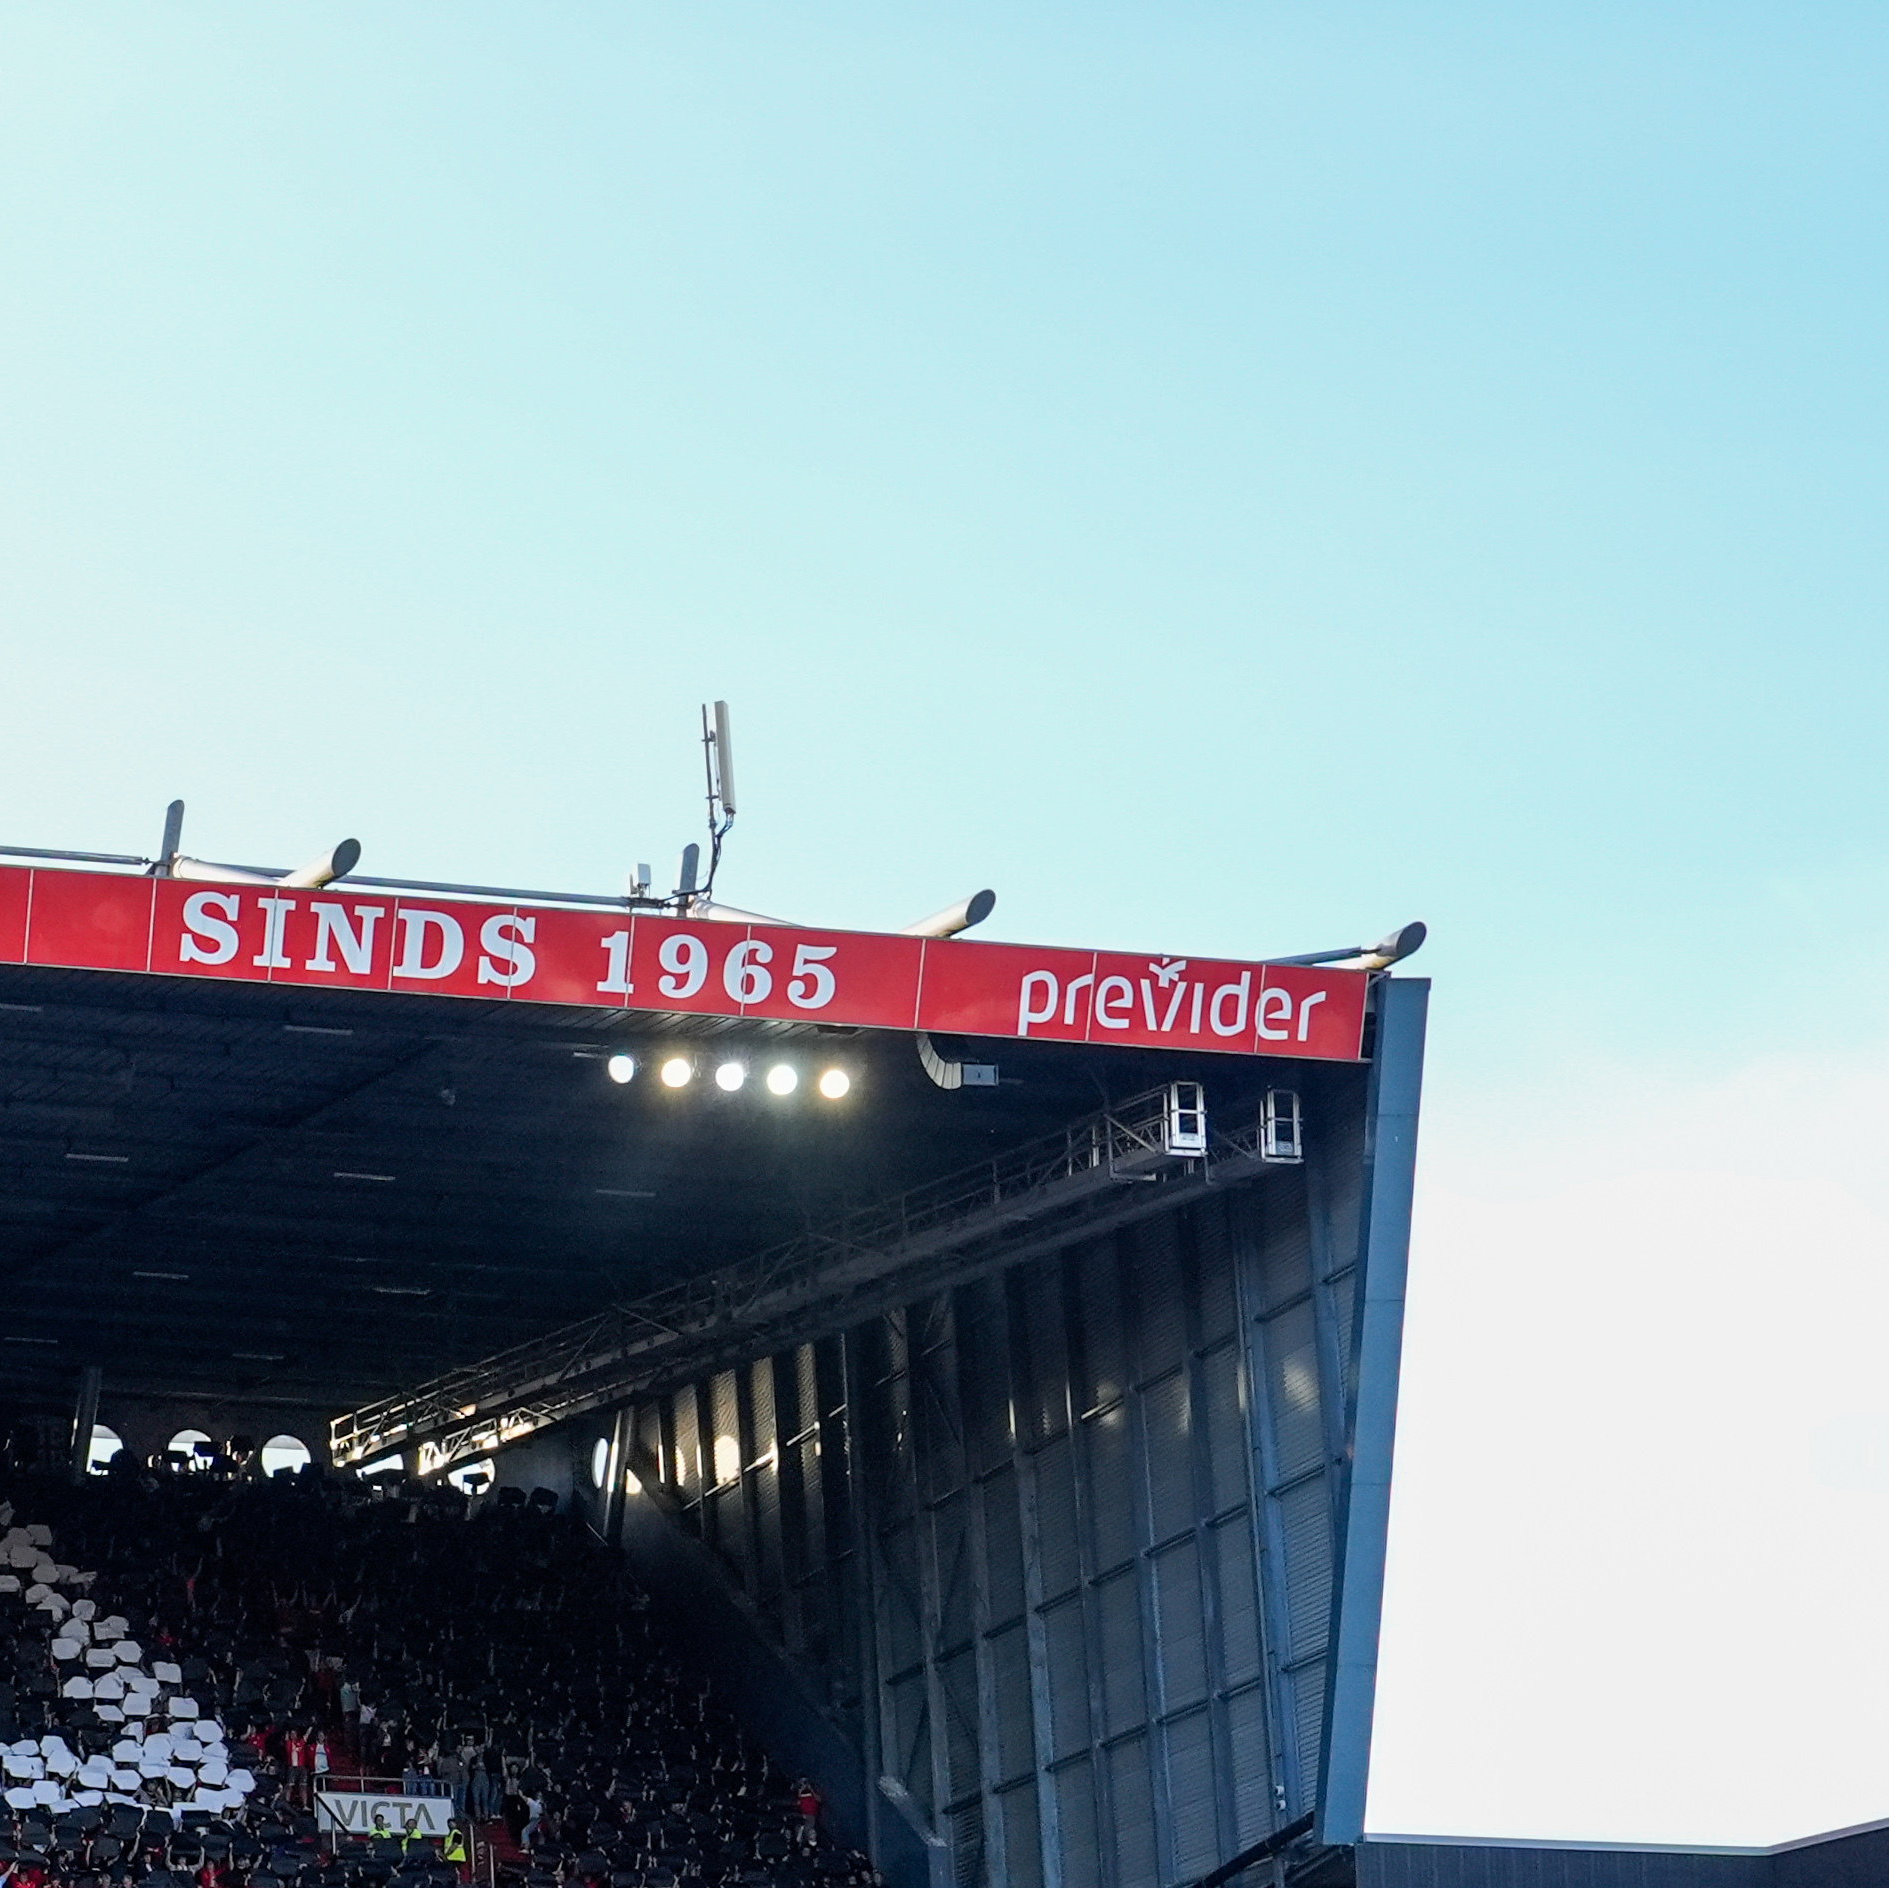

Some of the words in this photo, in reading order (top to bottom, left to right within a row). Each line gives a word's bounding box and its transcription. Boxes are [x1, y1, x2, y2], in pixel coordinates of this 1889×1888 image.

[178, 891, 537, 988] SINDS
[597, 929, 839, 1011] 1965
[1020, 956, 1326, 1044] previder
